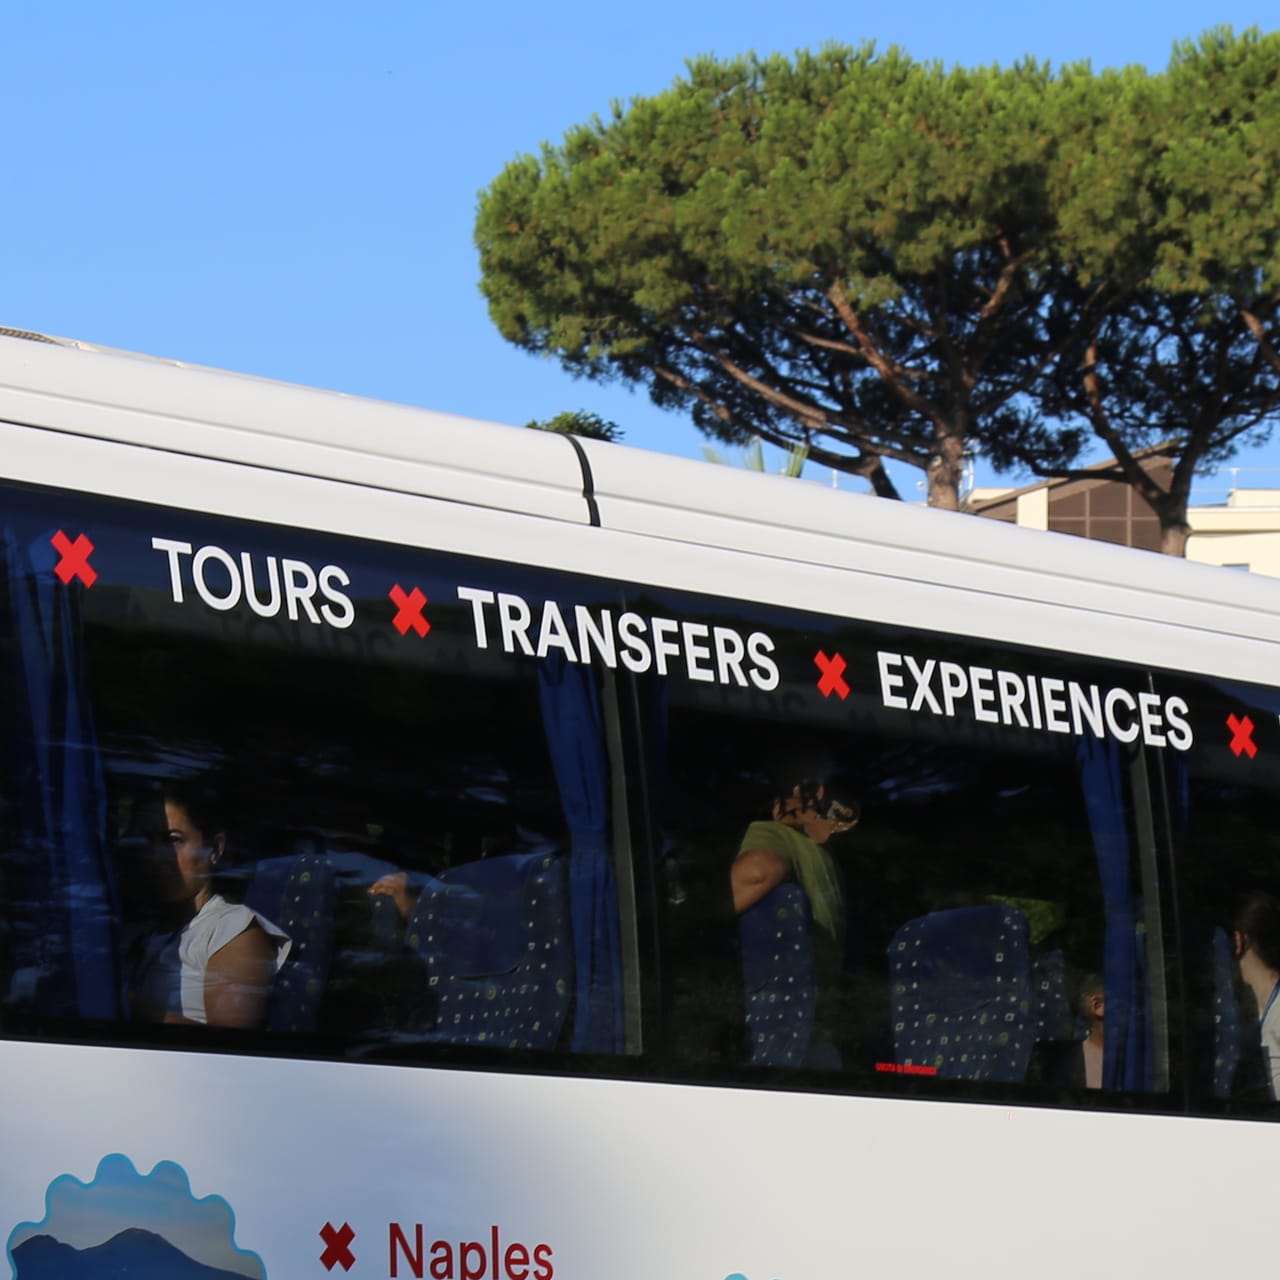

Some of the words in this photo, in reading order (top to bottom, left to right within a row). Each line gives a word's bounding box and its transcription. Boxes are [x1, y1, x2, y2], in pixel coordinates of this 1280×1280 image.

[151, 537, 355, 629] TOURS
[457, 585, 780, 692] TRANSFERS
[876, 650, 1194, 752] EXPERIENCES
